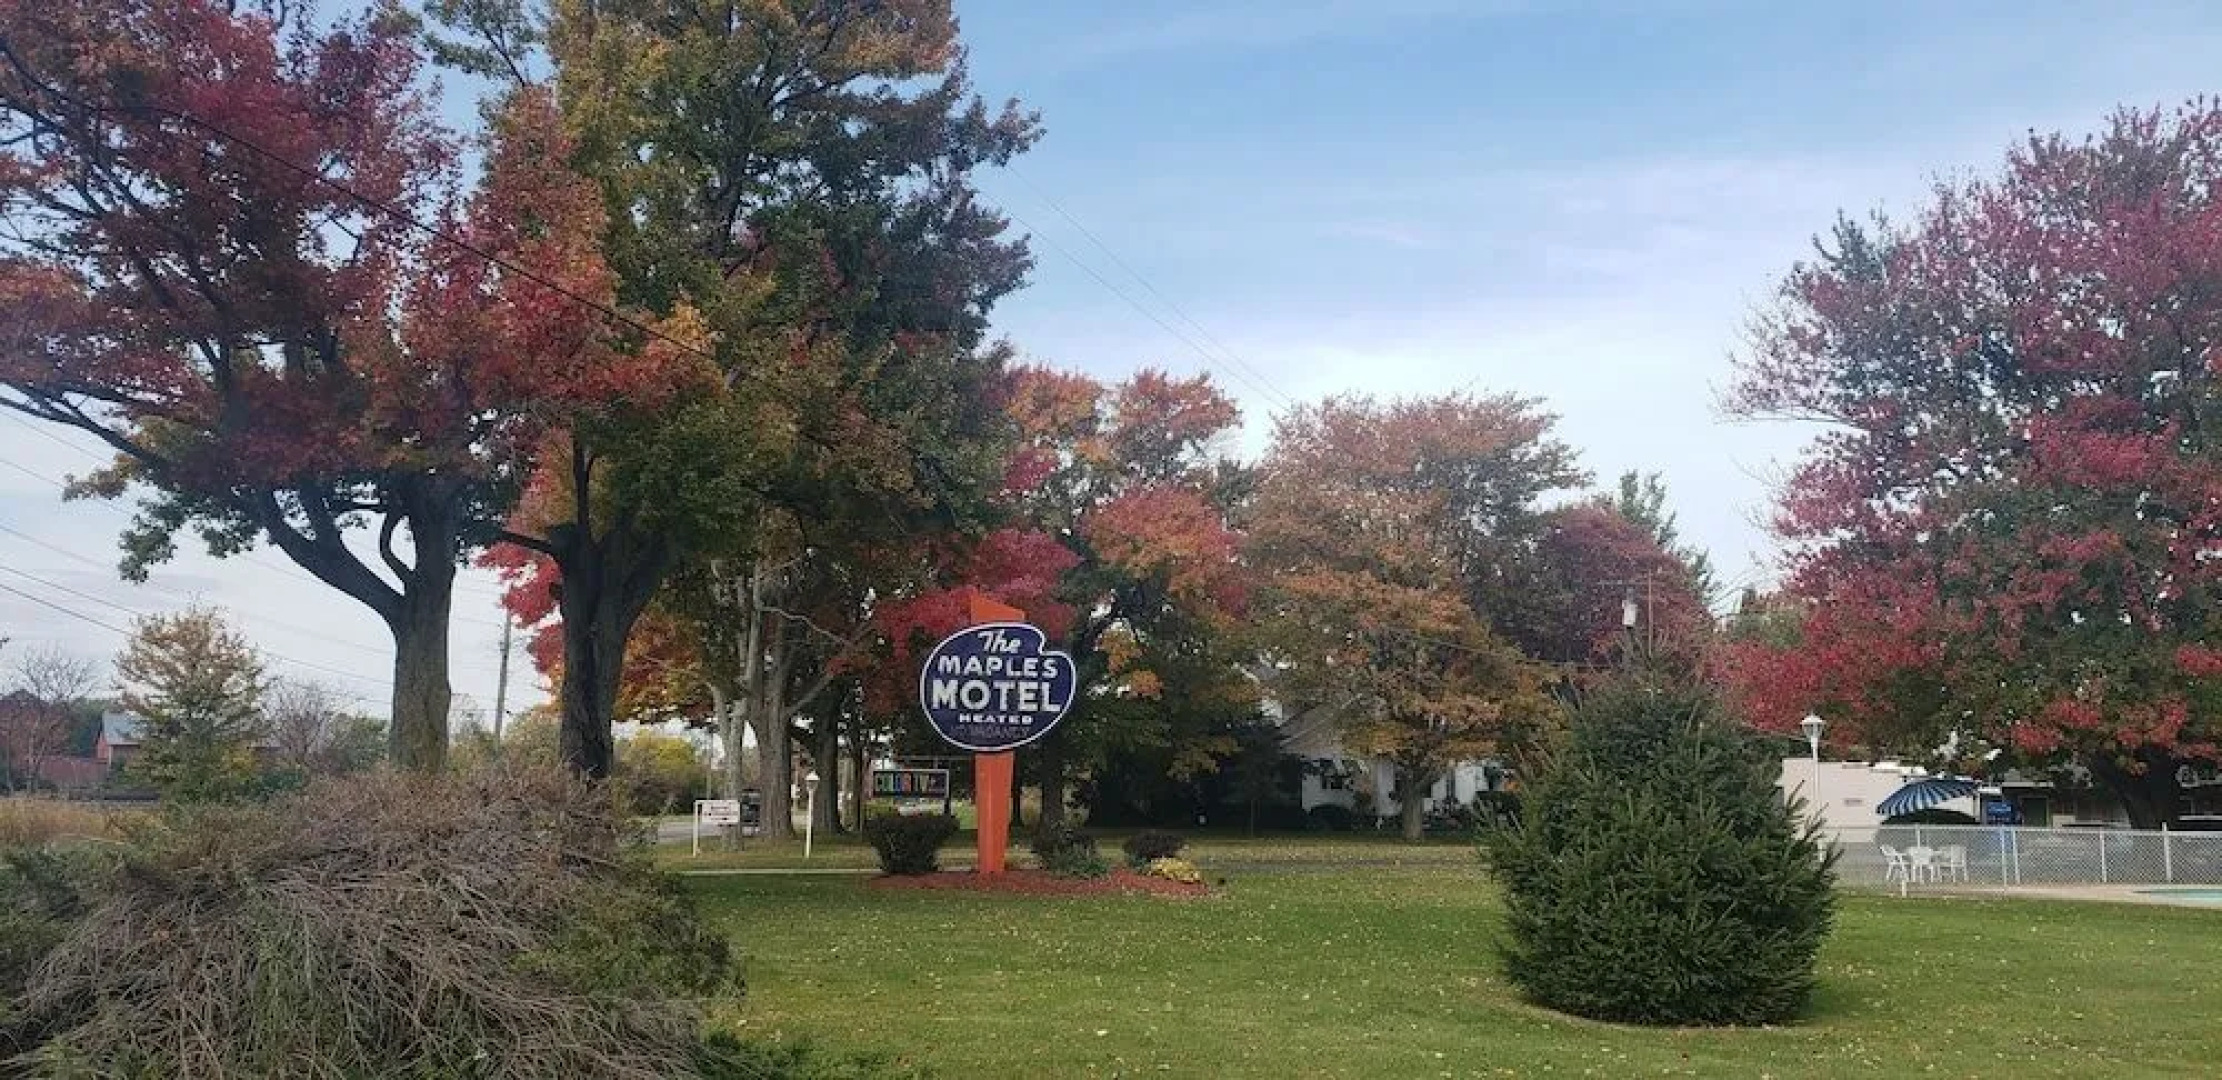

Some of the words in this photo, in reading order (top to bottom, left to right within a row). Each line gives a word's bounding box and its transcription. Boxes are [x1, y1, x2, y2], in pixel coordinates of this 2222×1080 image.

[978, 629, 1022, 653] The
[938, 655, 1059, 679] MAPLES
[932, 679, 1062, 712] MOTEL
[958, 713, 1034, 725] HEATED
